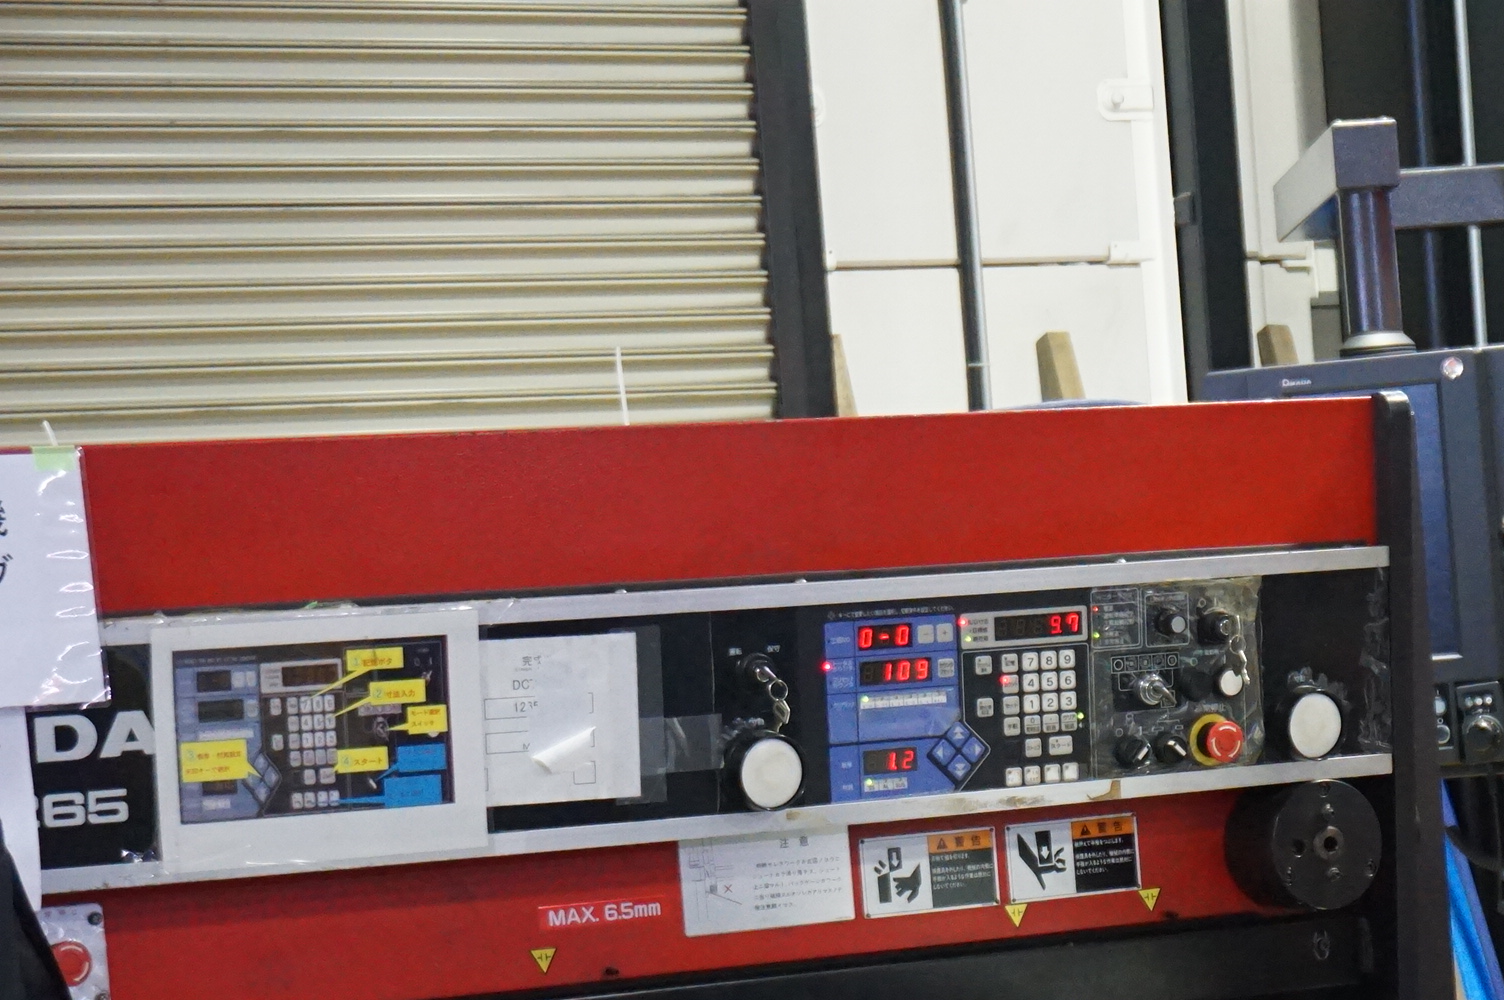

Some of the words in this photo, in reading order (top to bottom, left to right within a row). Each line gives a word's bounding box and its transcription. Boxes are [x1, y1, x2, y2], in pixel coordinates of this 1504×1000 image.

[1028, 657, 1034, 667] 7
[1046, 655, 1053, 666] 8
[1064, 654, 1071, 664] 9
[1028, 678, 1035, 688] 4
[1046, 676, 1054, 687] 5
[1064, 675, 1072, 685] 6
[1047, 698, 1054, 708] 2
[1065, 696, 1073, 707] 3
[35, 788, 129, 828] 65
[548, 906, 600, 927] MAX.
[604, 901, 661, 921] 6.5mm
